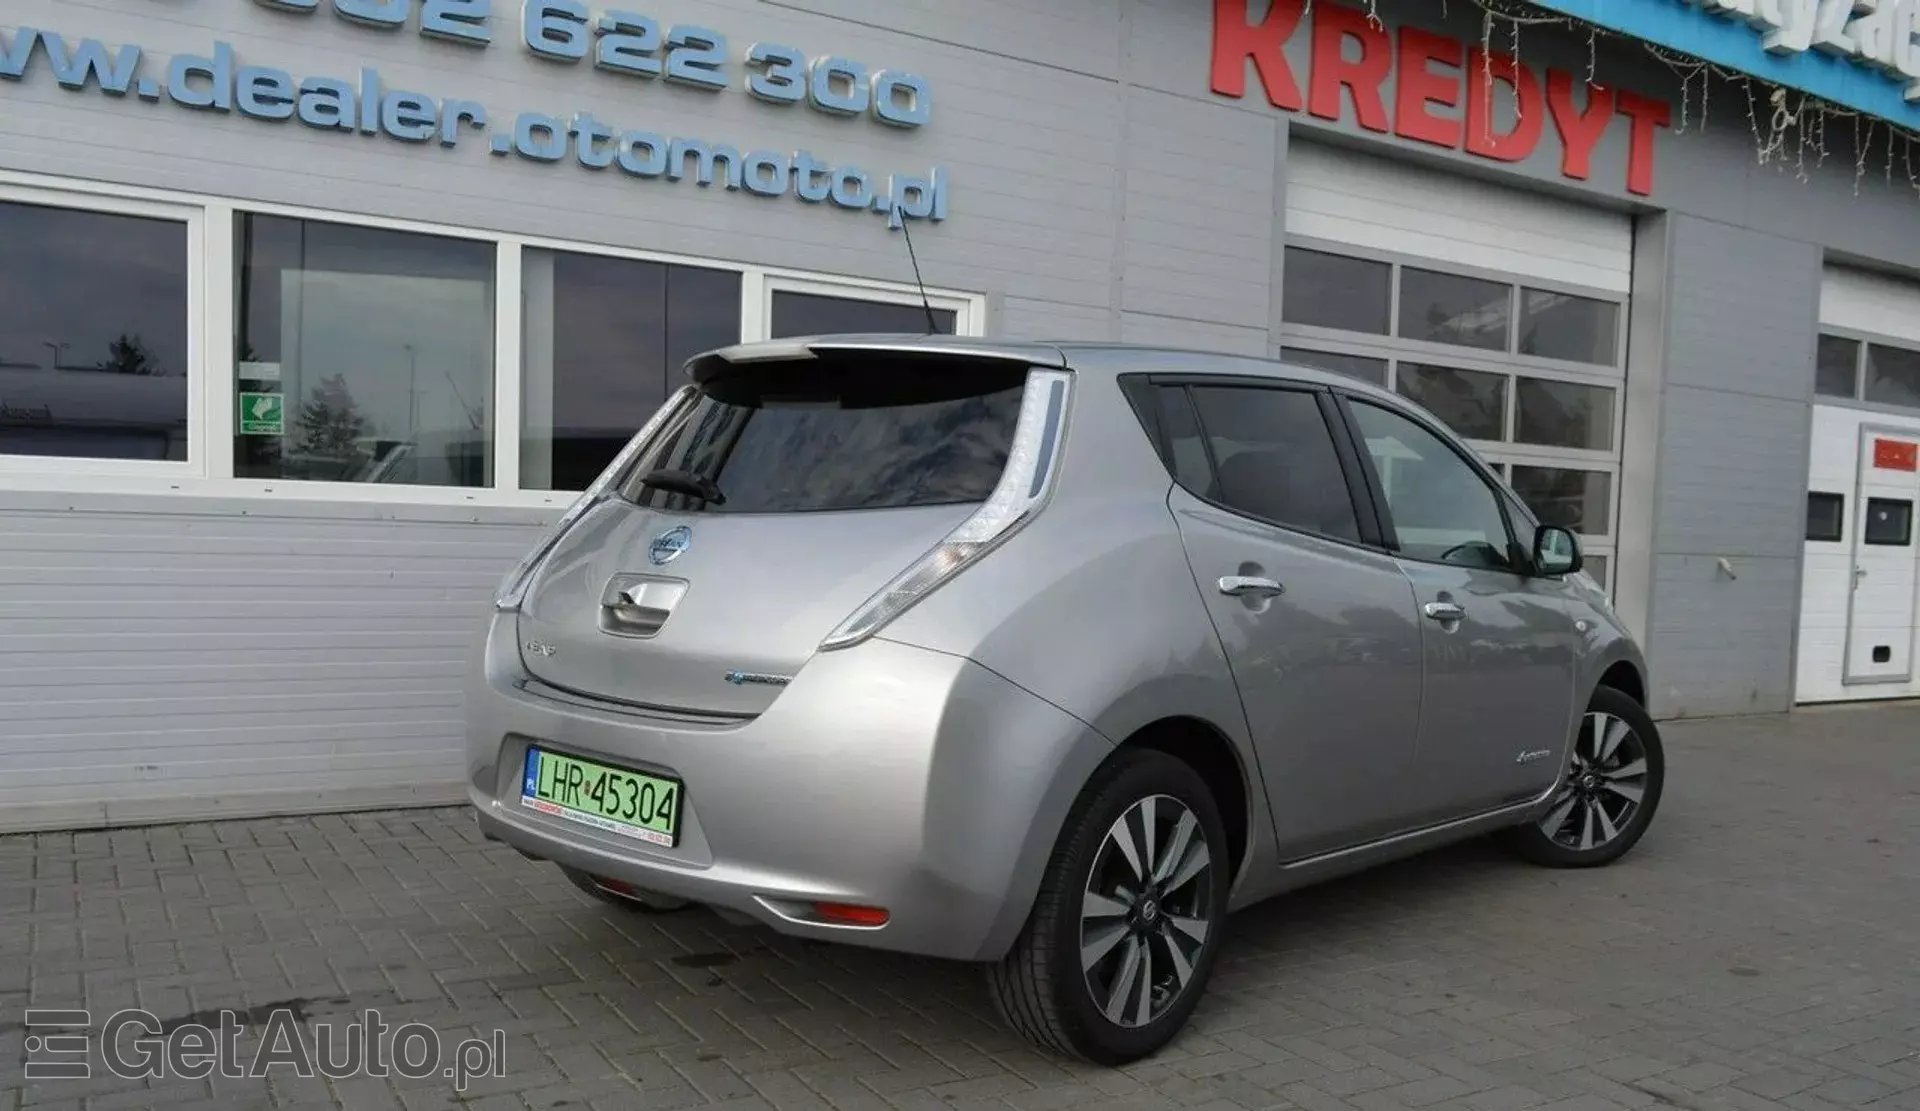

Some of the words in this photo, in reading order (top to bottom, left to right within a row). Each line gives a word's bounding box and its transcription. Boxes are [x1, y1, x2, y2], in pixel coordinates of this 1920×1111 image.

[520, 0, 730, 92] 622
[744, 41, 932, 129] 300
[1209, 0, 1671, 198] KREDYT
[538, 756, 581, 806] LHR
[591, 771, 675, 831] 45304
